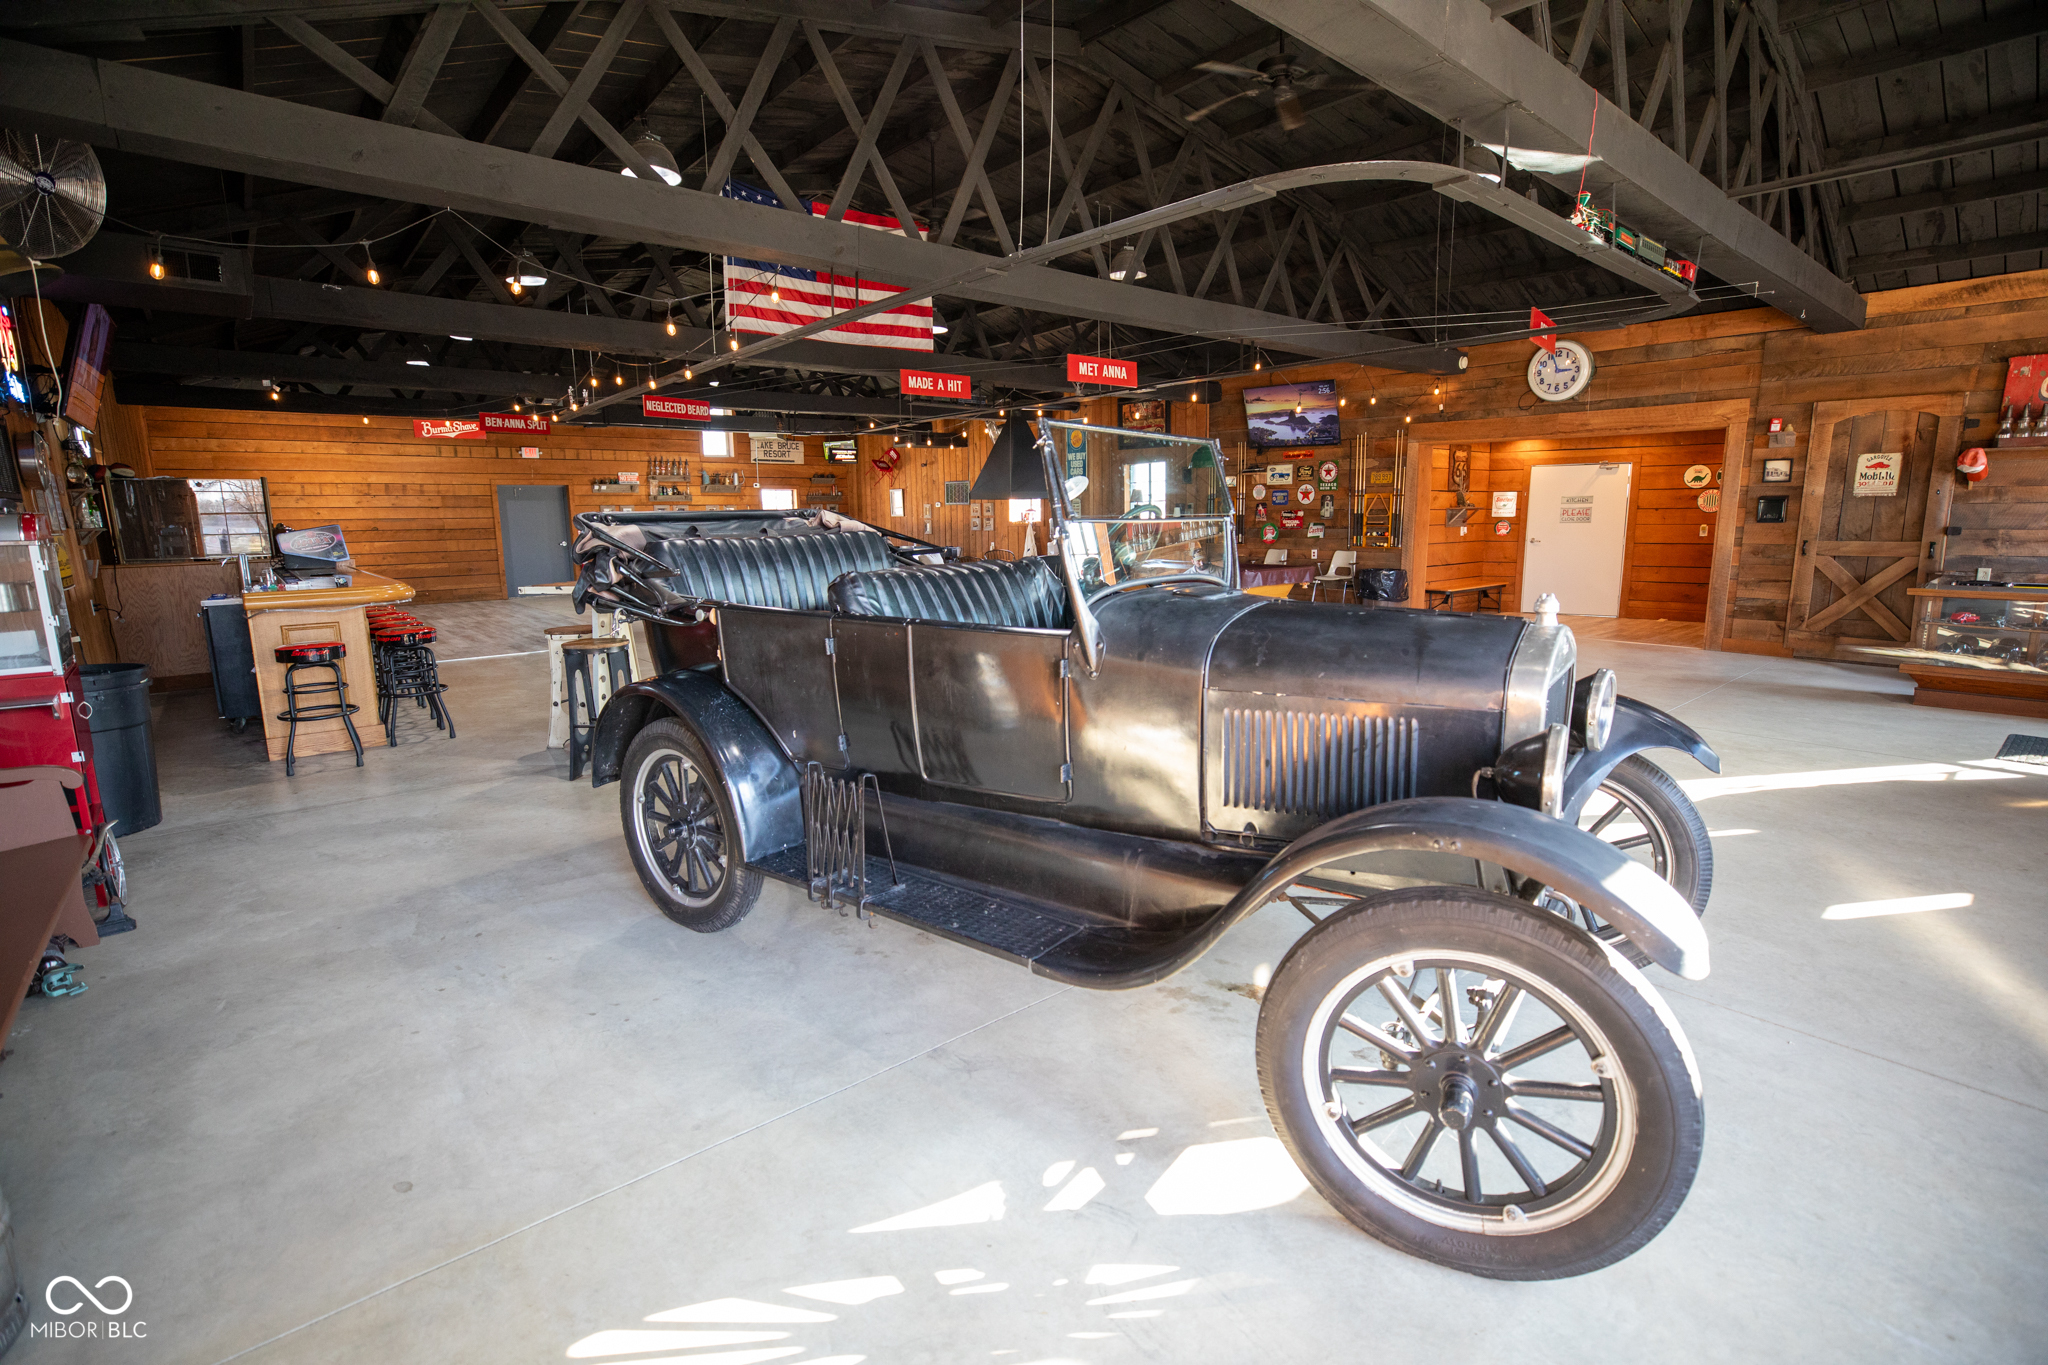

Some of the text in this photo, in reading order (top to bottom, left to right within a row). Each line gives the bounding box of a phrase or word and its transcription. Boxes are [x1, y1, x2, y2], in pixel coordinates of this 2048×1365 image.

[1078, 362, 1127, 380] MET ANNA
[908, 376, 962, 392] MADE A HIT
[646, 400, 709, 416] NEGLECTED BEARD
[527, 420, 547, 430] SPLIT
[756, 440, 800, 450] AKE BRUCE
[524, 448, 537, 457] EXIT
[763, 450, 791, 458] RESORT
[1455, 462, 1466, 477] 66
[1562, 508, 1590, 516] PLEASE
